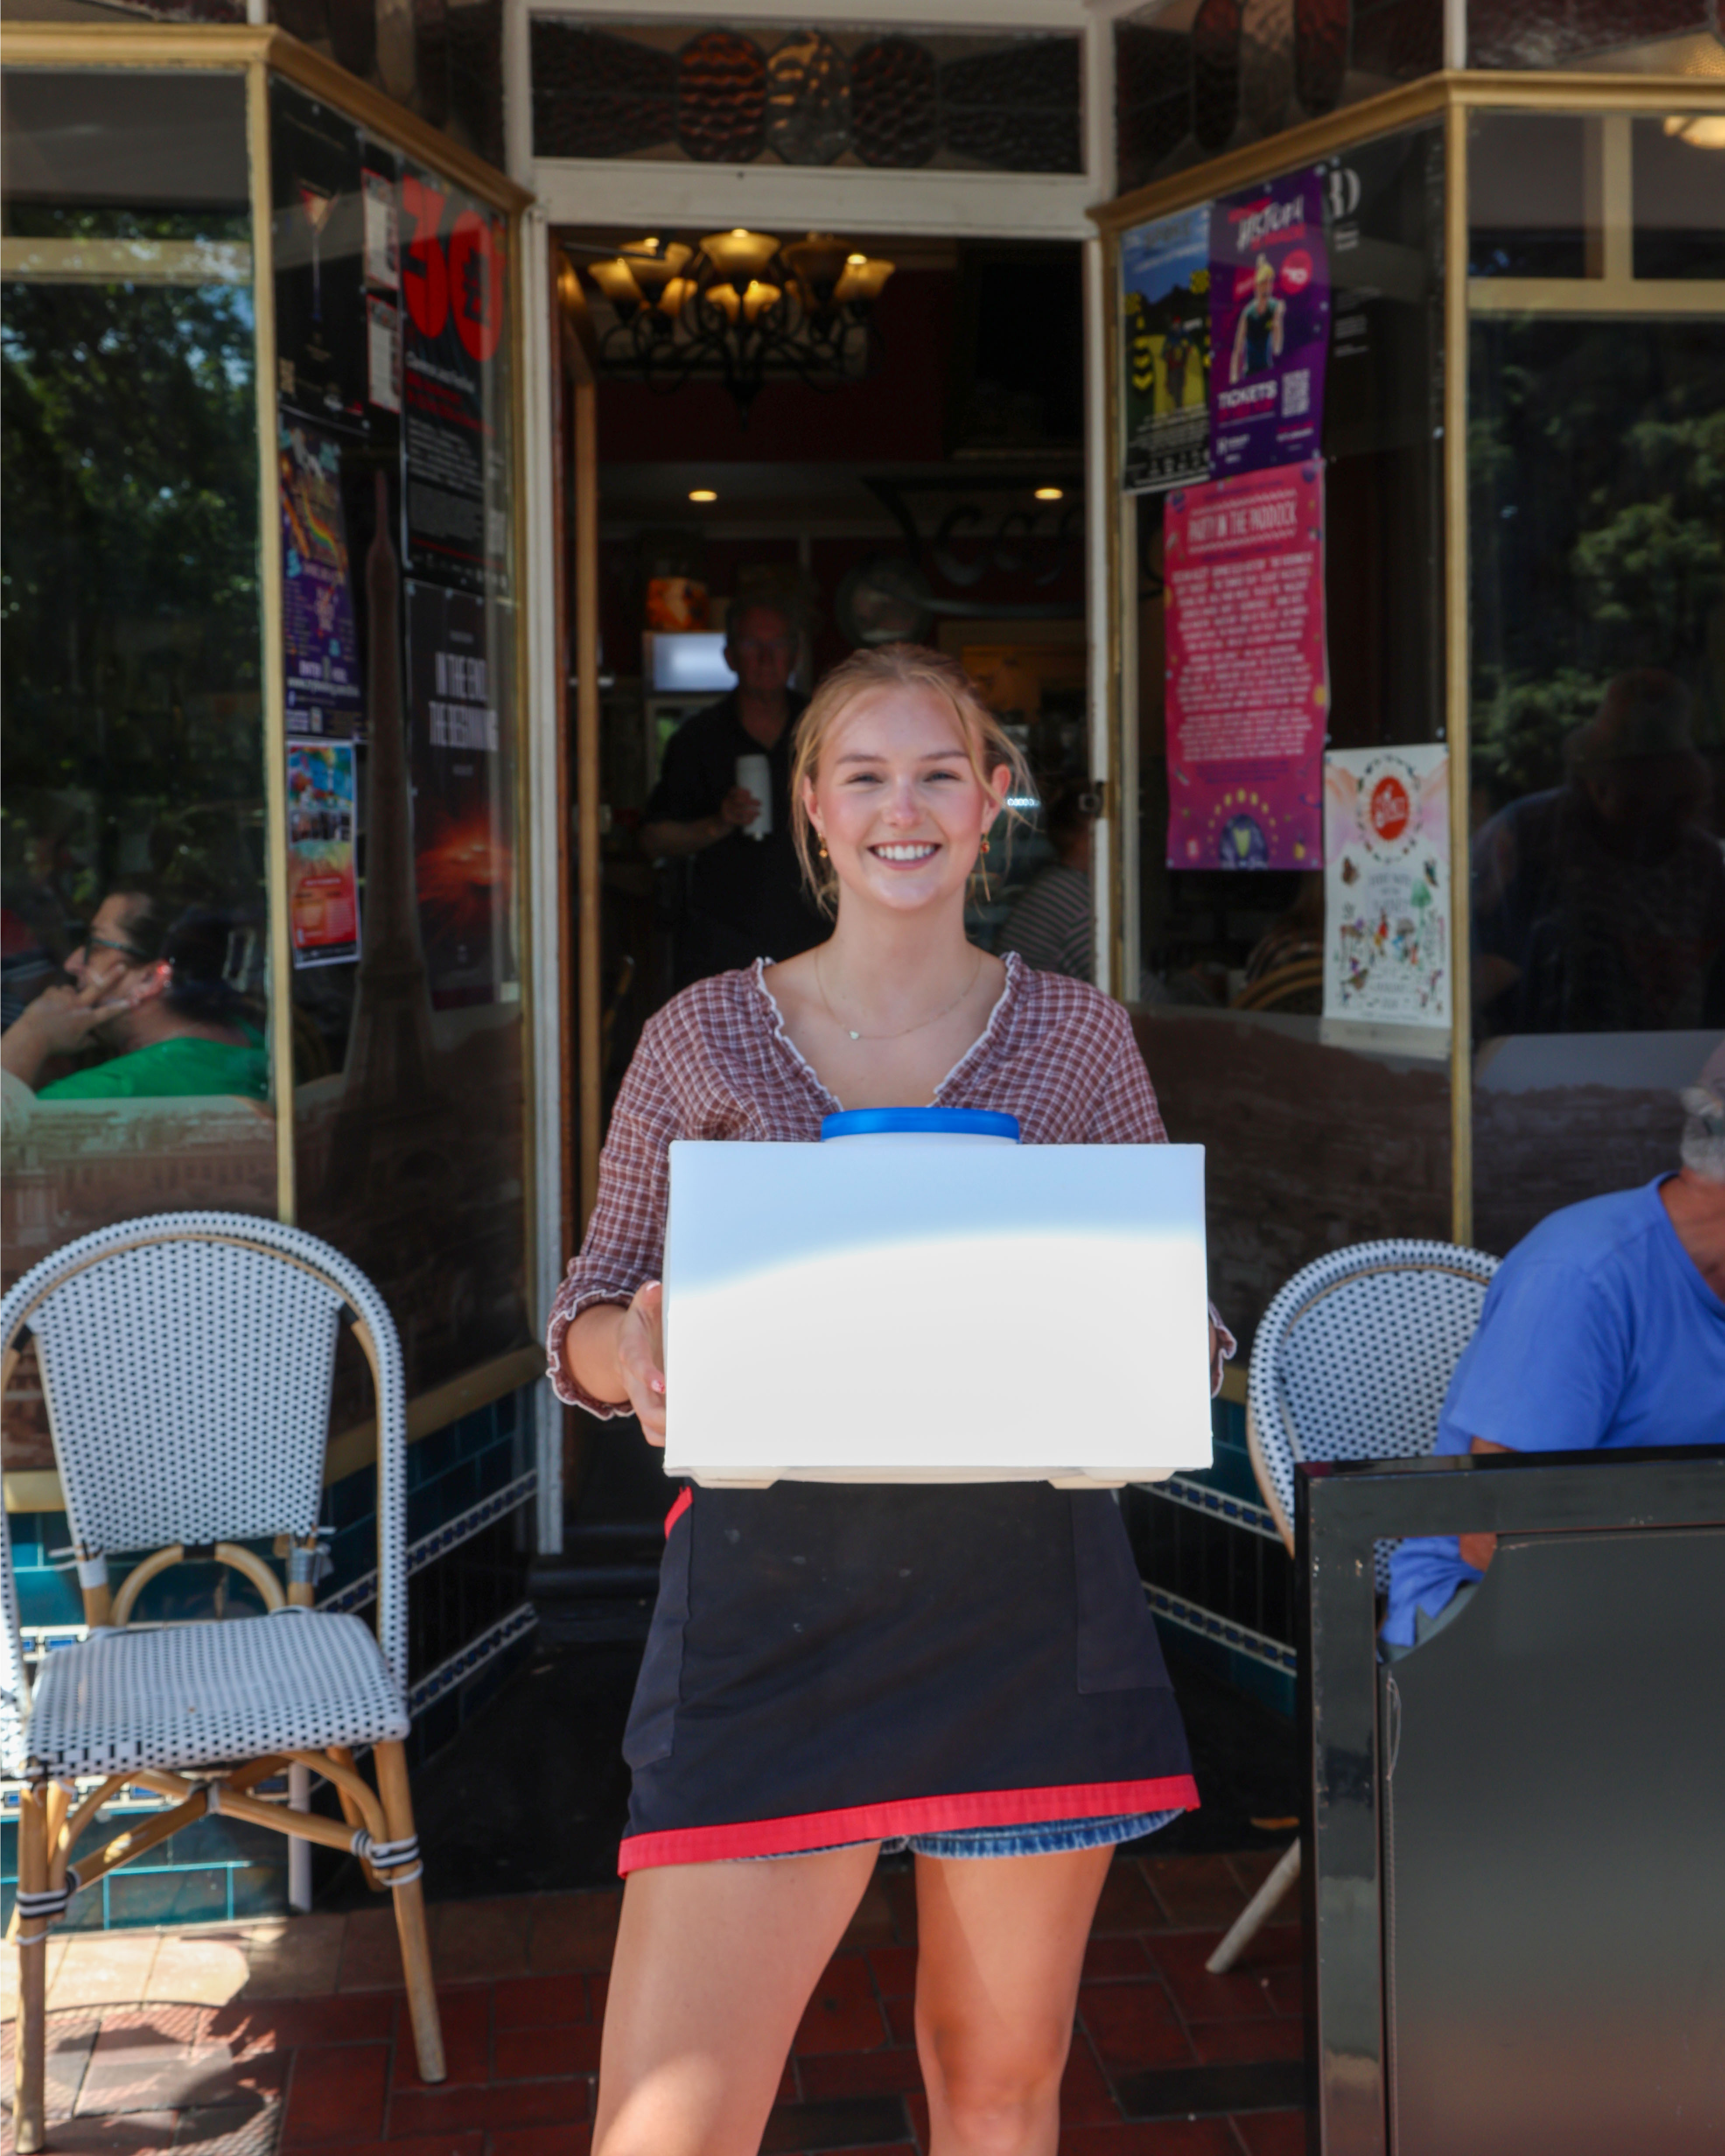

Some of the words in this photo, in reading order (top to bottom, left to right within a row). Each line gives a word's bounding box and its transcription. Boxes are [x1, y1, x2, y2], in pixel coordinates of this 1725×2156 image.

[1217, 380, 1277, 410] TICKETS
[1217, 513, 1228, 538] IN
[1229, 509, 1247, 535] THE
[1249, 500, 1298, 531] PADDOCK
[435, 651, 448, 696] IN
[447, 653, 467, 699] THE
[429, 700, 448, 747] THE
